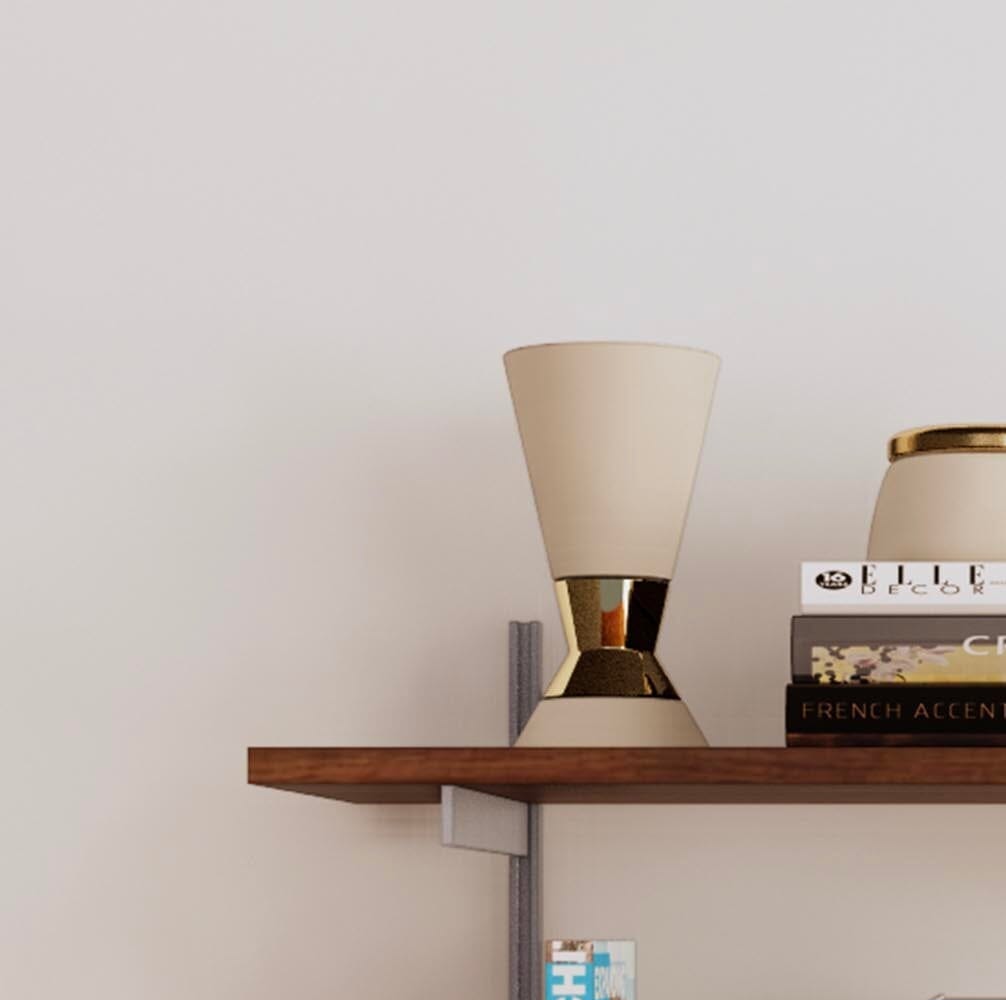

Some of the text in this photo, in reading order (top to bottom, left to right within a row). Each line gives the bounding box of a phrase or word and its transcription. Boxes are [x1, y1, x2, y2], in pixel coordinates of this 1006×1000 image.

[862, 564, 985, 586] ELLE
[861, 584, 985, 595] DECOR
[802, 702, 901, 720] FRENCH
